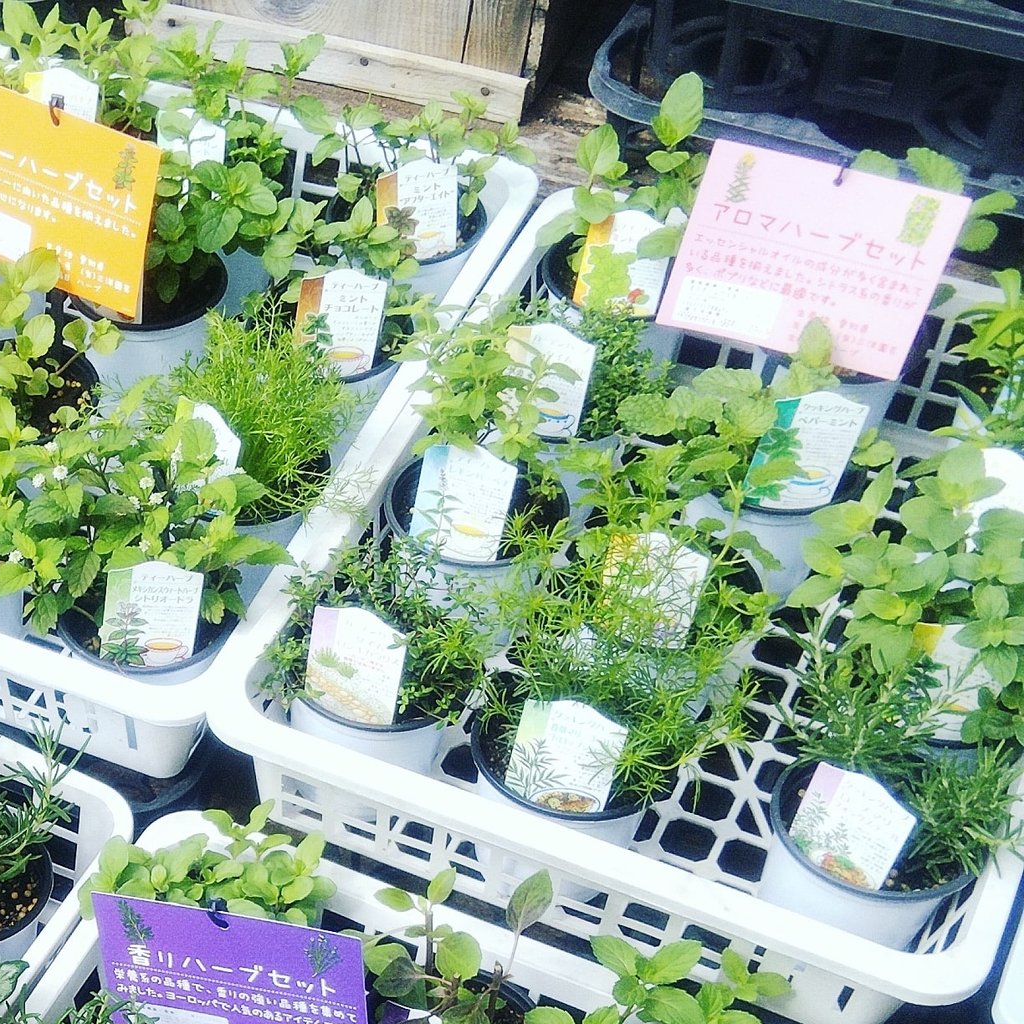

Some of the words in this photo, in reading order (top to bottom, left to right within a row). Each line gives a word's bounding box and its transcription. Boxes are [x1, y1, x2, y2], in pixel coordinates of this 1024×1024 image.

[414, 182, 440, 193] ミント
[713, 203, 926, 270] アロマハーブセット
[694, 233, 924, 297] エッセンシャルオイルの成分が多く含まれて
[324, 304, 379, 313] チョコレート
[339, 295, 368, 303] ミント
[113, 968, 358, 1023] 栄養系の品種で、香りの強い品種を集めて
[127, 944, 337, 997] 香りハーブセット
